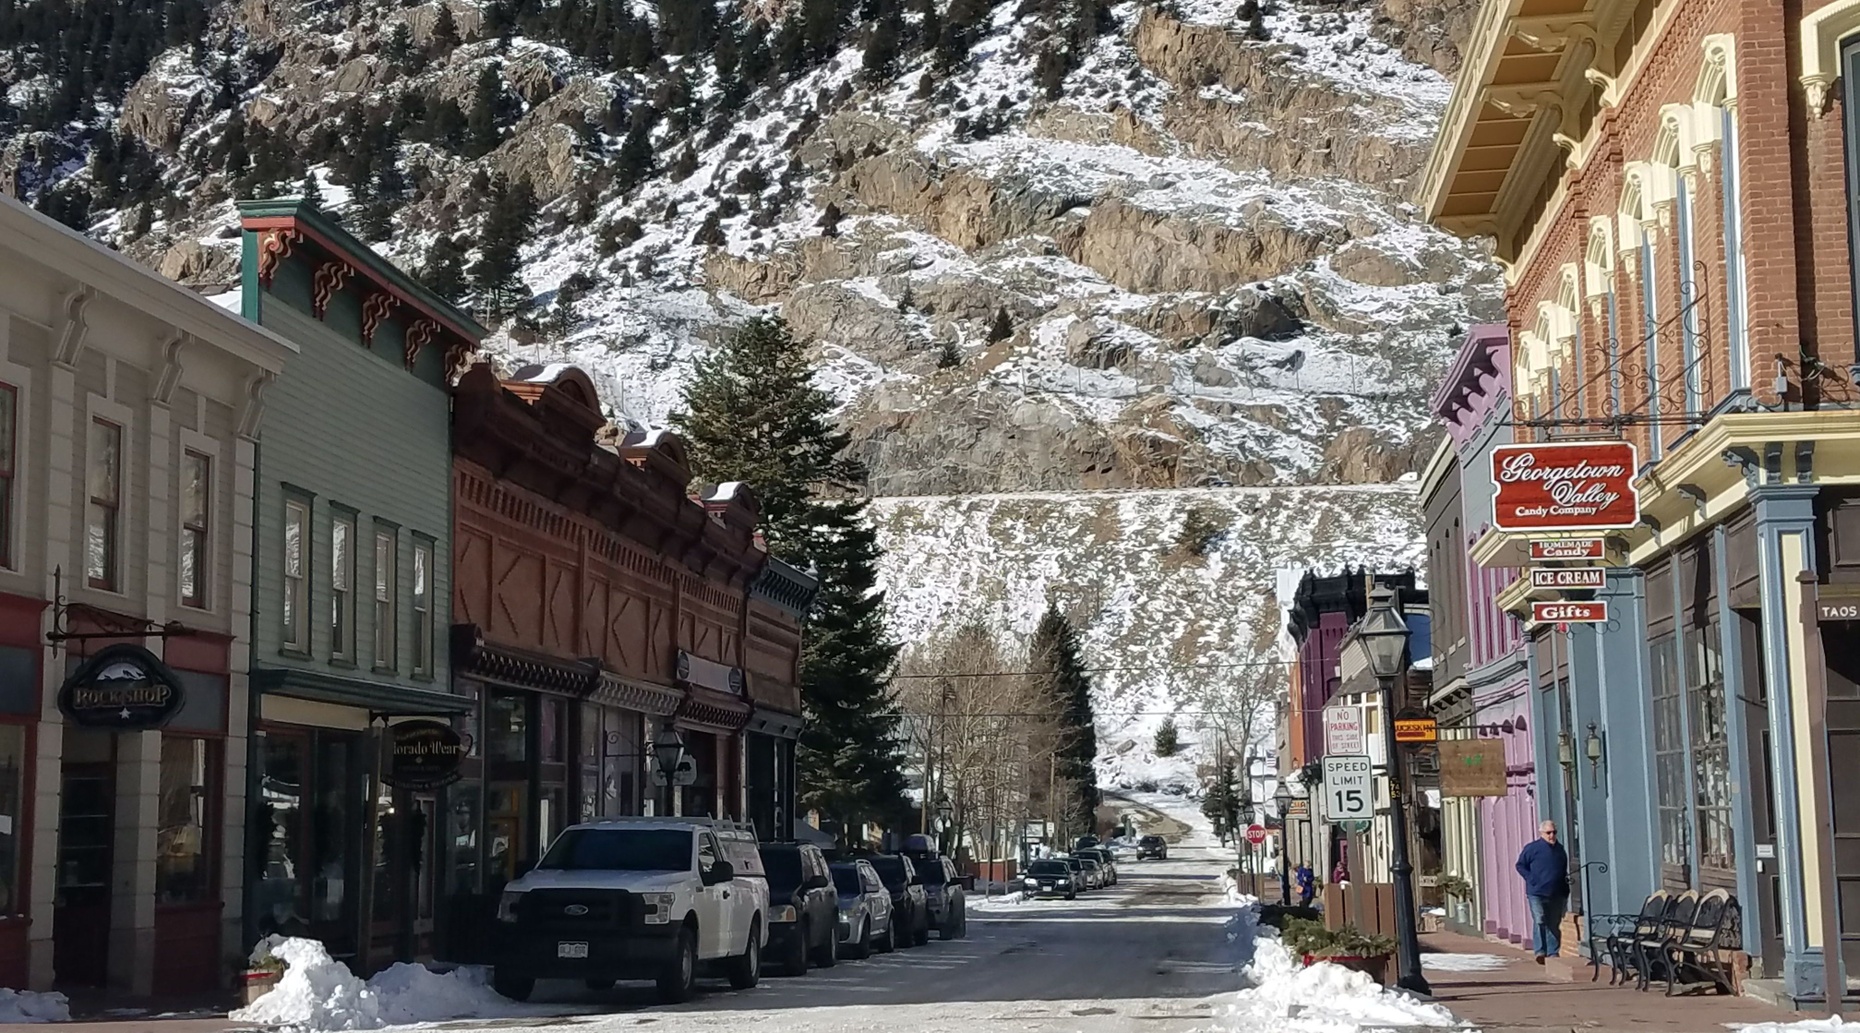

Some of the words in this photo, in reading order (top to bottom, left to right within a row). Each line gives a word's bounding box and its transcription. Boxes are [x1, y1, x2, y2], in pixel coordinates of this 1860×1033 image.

[1501, 452, 1625, 490] Georgetown
[1552, 480, 1620, 509] Valley
[1515, 506, 1548, 517] Candy
[1550, 505, 1597, 516] Company
[1543, 547, 1590, 557] Candy
[1535, 572, 1554, 585] ICE
[1557, 571, 1600, 584] CREAM
[1541, 605, 1591, 618] Gifts
[1822, 606, 1857, 617] TAOS
[76, 688, 122, 705] ROCK
[124, 684, 169, 704] SHOP
[1337, 711, 1350, 720] NO
[1330, 722, 1358, 731] PARKING
[1396, 724, 1433, 732] UCKSKIN
[393, 741, 428, 755] lorado
[430, 741, 457, 755] Wear
[1327, 762, 1368, 772] SPEED
[1332, 776, 1363, 786] LIMIT
[1335, 790, 1364, 813] 15
[1248, 830, 1265, 839] STOP
